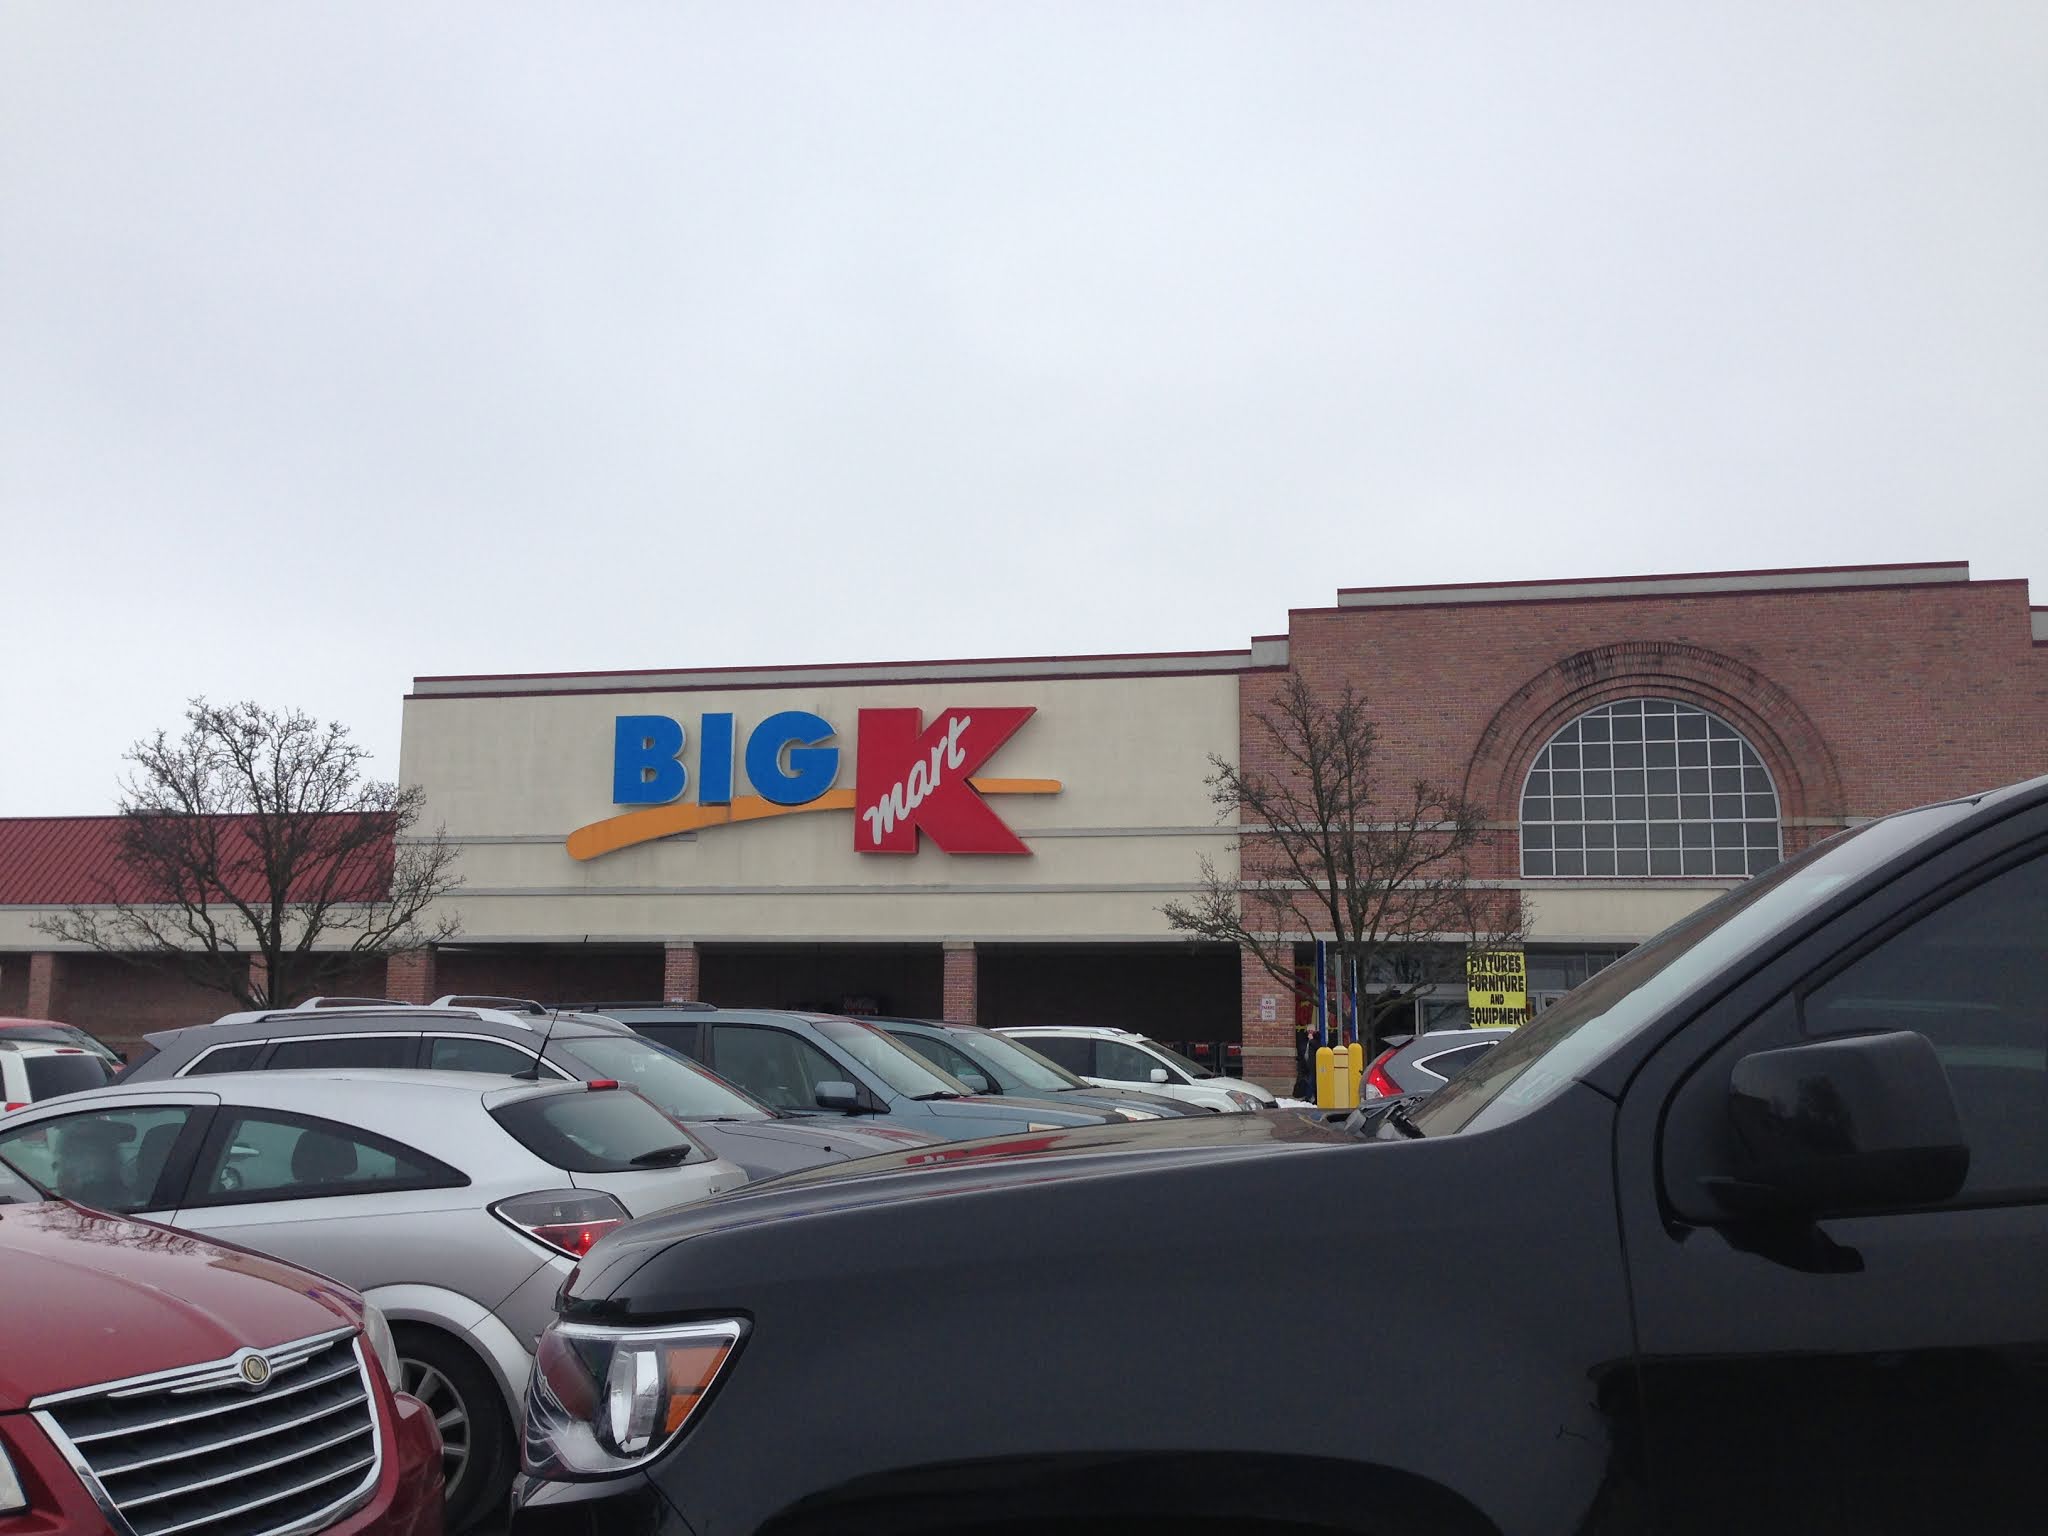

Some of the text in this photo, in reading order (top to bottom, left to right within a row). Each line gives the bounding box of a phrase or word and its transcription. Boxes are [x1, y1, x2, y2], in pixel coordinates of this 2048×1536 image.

[613, 707, 1037, 855] BIG K
[863, 715, 971, 845] mart
[1471, 955, 1521, 973] FIXTURES
[1468, 975, 1524, 992] FURNITURE
[1490, 994, 1504, 1005] AND
[1470, 1007, 1527, 1026] EQUIPMENT
